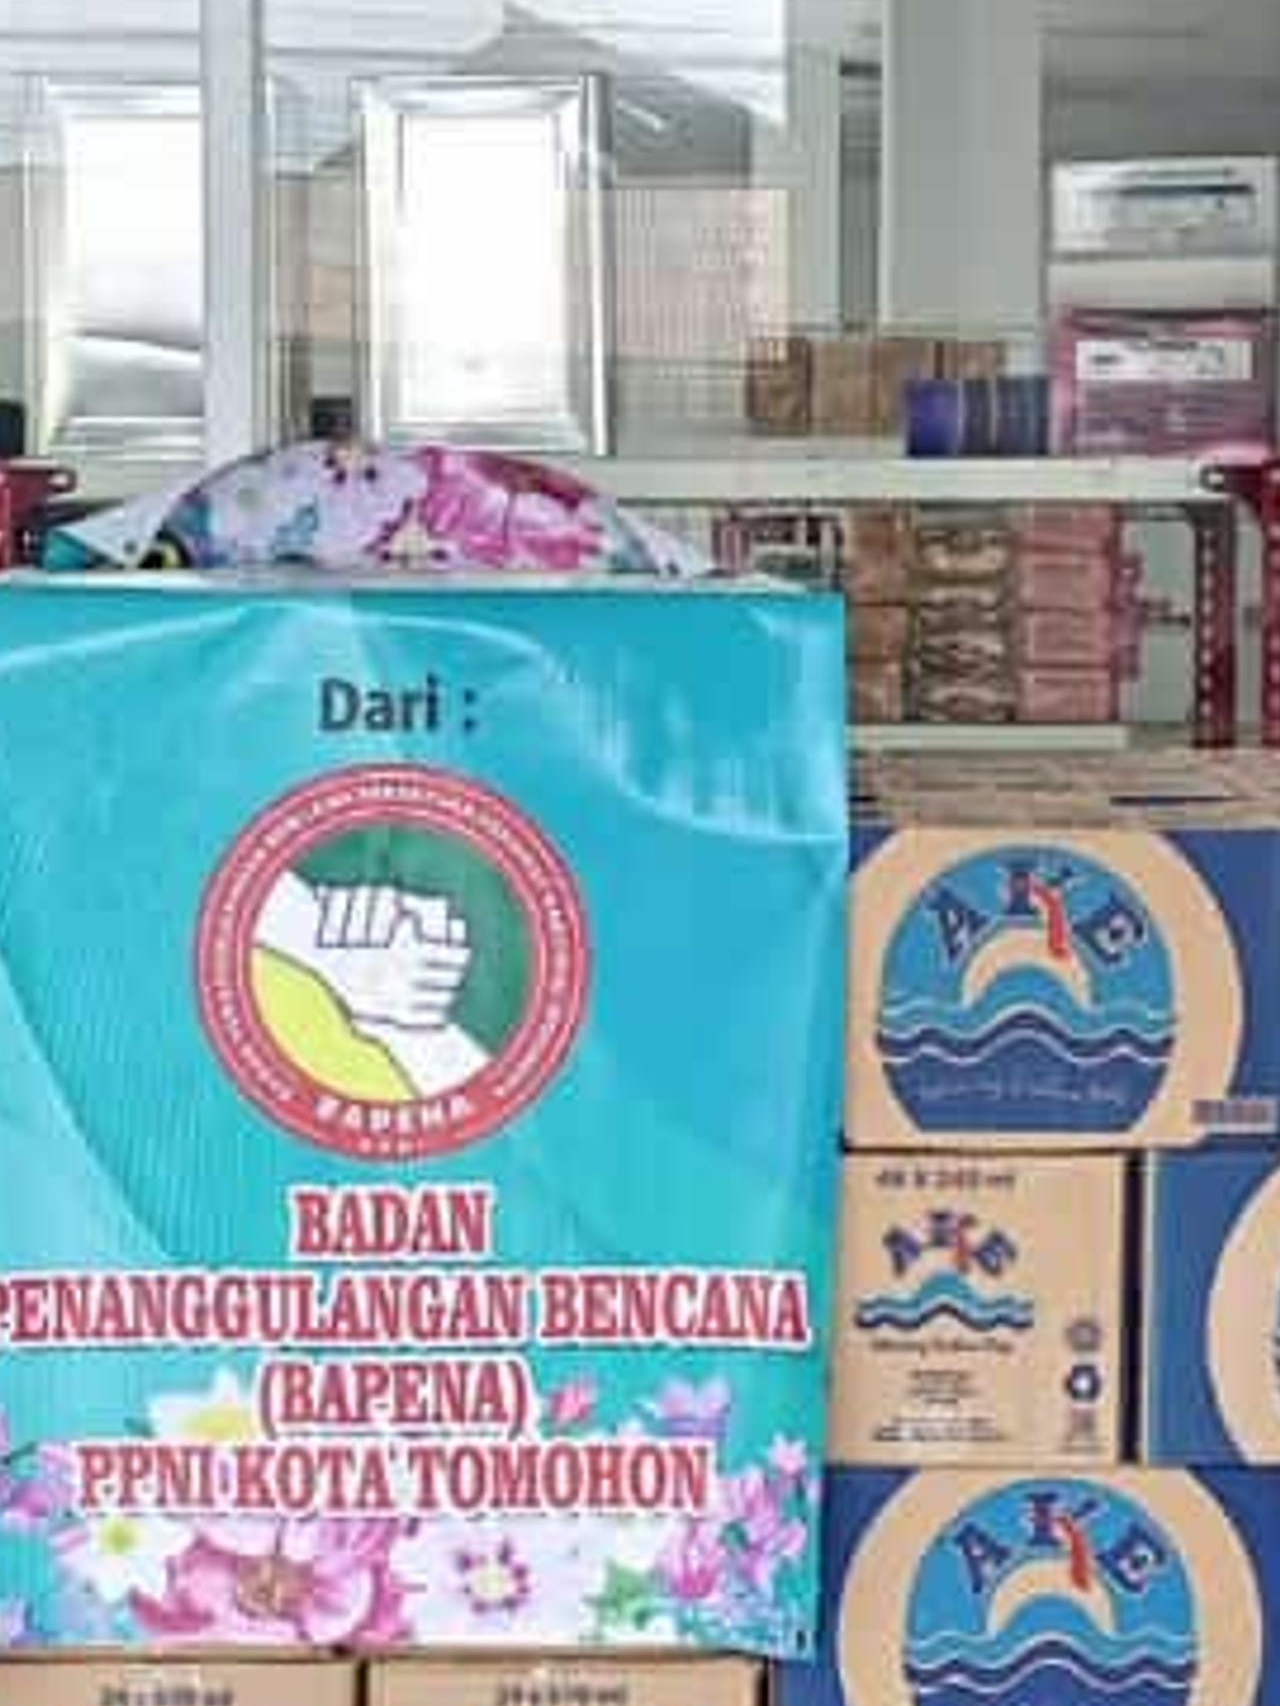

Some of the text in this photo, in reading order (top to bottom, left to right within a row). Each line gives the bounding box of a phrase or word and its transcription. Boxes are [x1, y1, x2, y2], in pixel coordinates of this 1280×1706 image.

[319, 674, 440, 732] Dari
[926, 860, 1149, 967] AKE
[293, 1190, 489, 1255] BADAN
[540, 1274, 807, 1342] BENCANA
[259, 1359, 532, 1437] (BAPENA)
[78, 1445, 709, 1510] PPNI KOTA TOMOHON
[950, 1492, 1170, 1595] AKE
